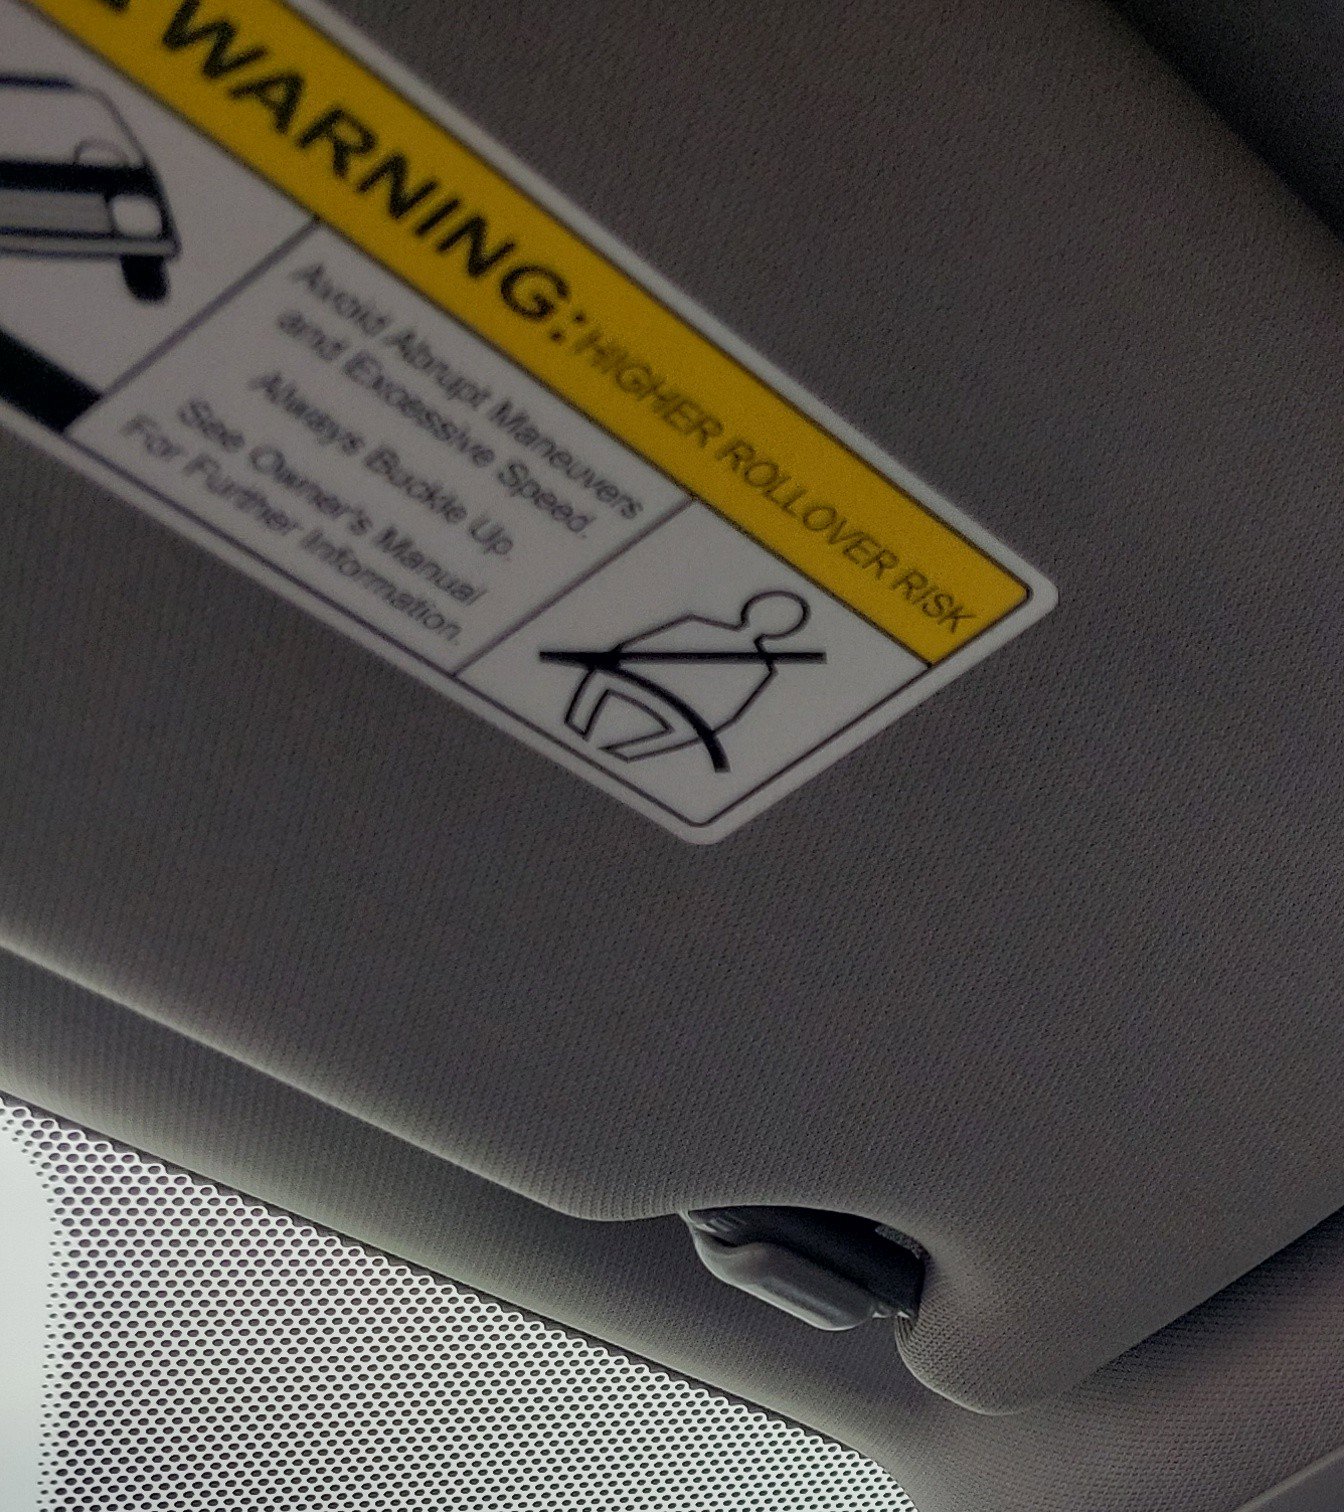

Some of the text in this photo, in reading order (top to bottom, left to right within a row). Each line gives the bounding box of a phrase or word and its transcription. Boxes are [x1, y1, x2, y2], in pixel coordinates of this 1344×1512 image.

[162, 0, 974, 634] WARNING: HIGHER ROLLOVER RISK
[276, 312, 596, 539] and Excessive Speed.
[290, 261, 644, 521] Avoid Abrupt Maneuvers
[121, 413, 463, 646] For Further Information.
[176, 399, 486, 606] See Owner's Manual
[252, 371, 516, 562] Always Buckle Up.
